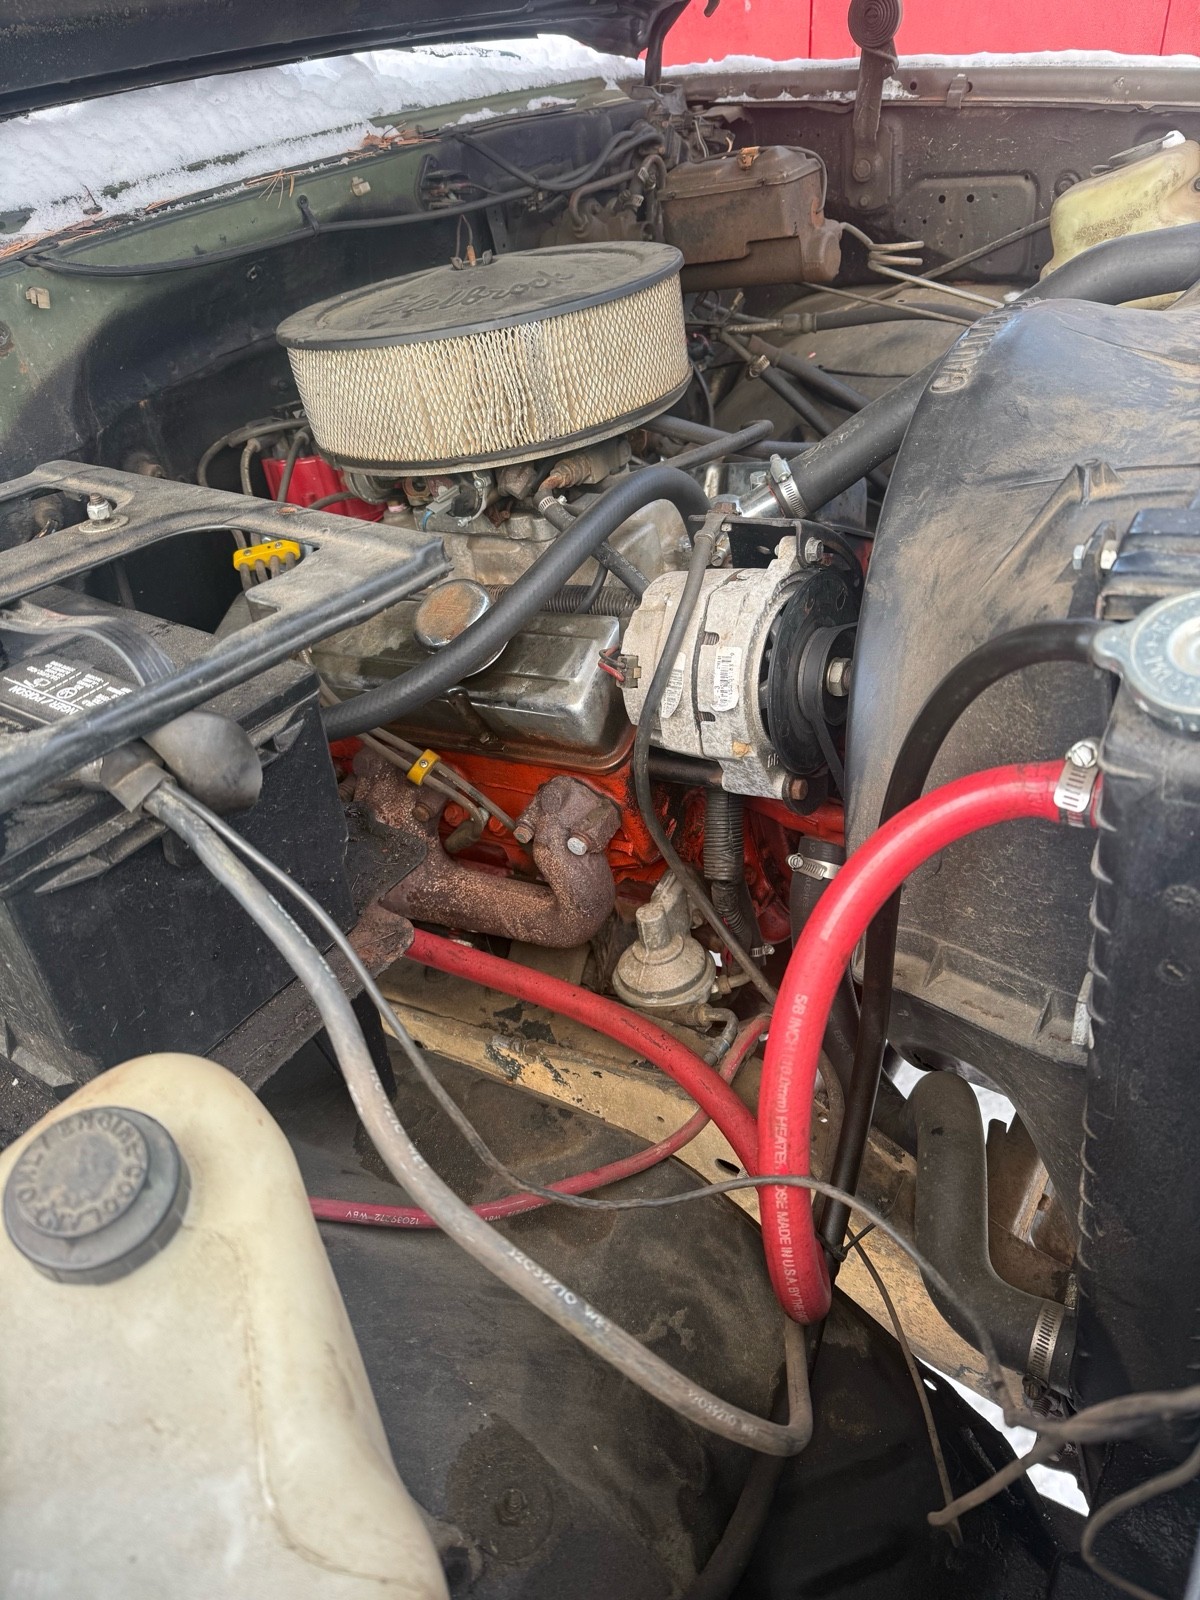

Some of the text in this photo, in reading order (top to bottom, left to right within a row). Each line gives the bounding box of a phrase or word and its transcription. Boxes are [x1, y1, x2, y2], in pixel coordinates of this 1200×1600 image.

[49, 700, 79, 715] NGER
[791, 993, 809, 1016] 5/8
[777, 1211, 792, 1245] MADE
[788, 1285, 802, 1301] BY
